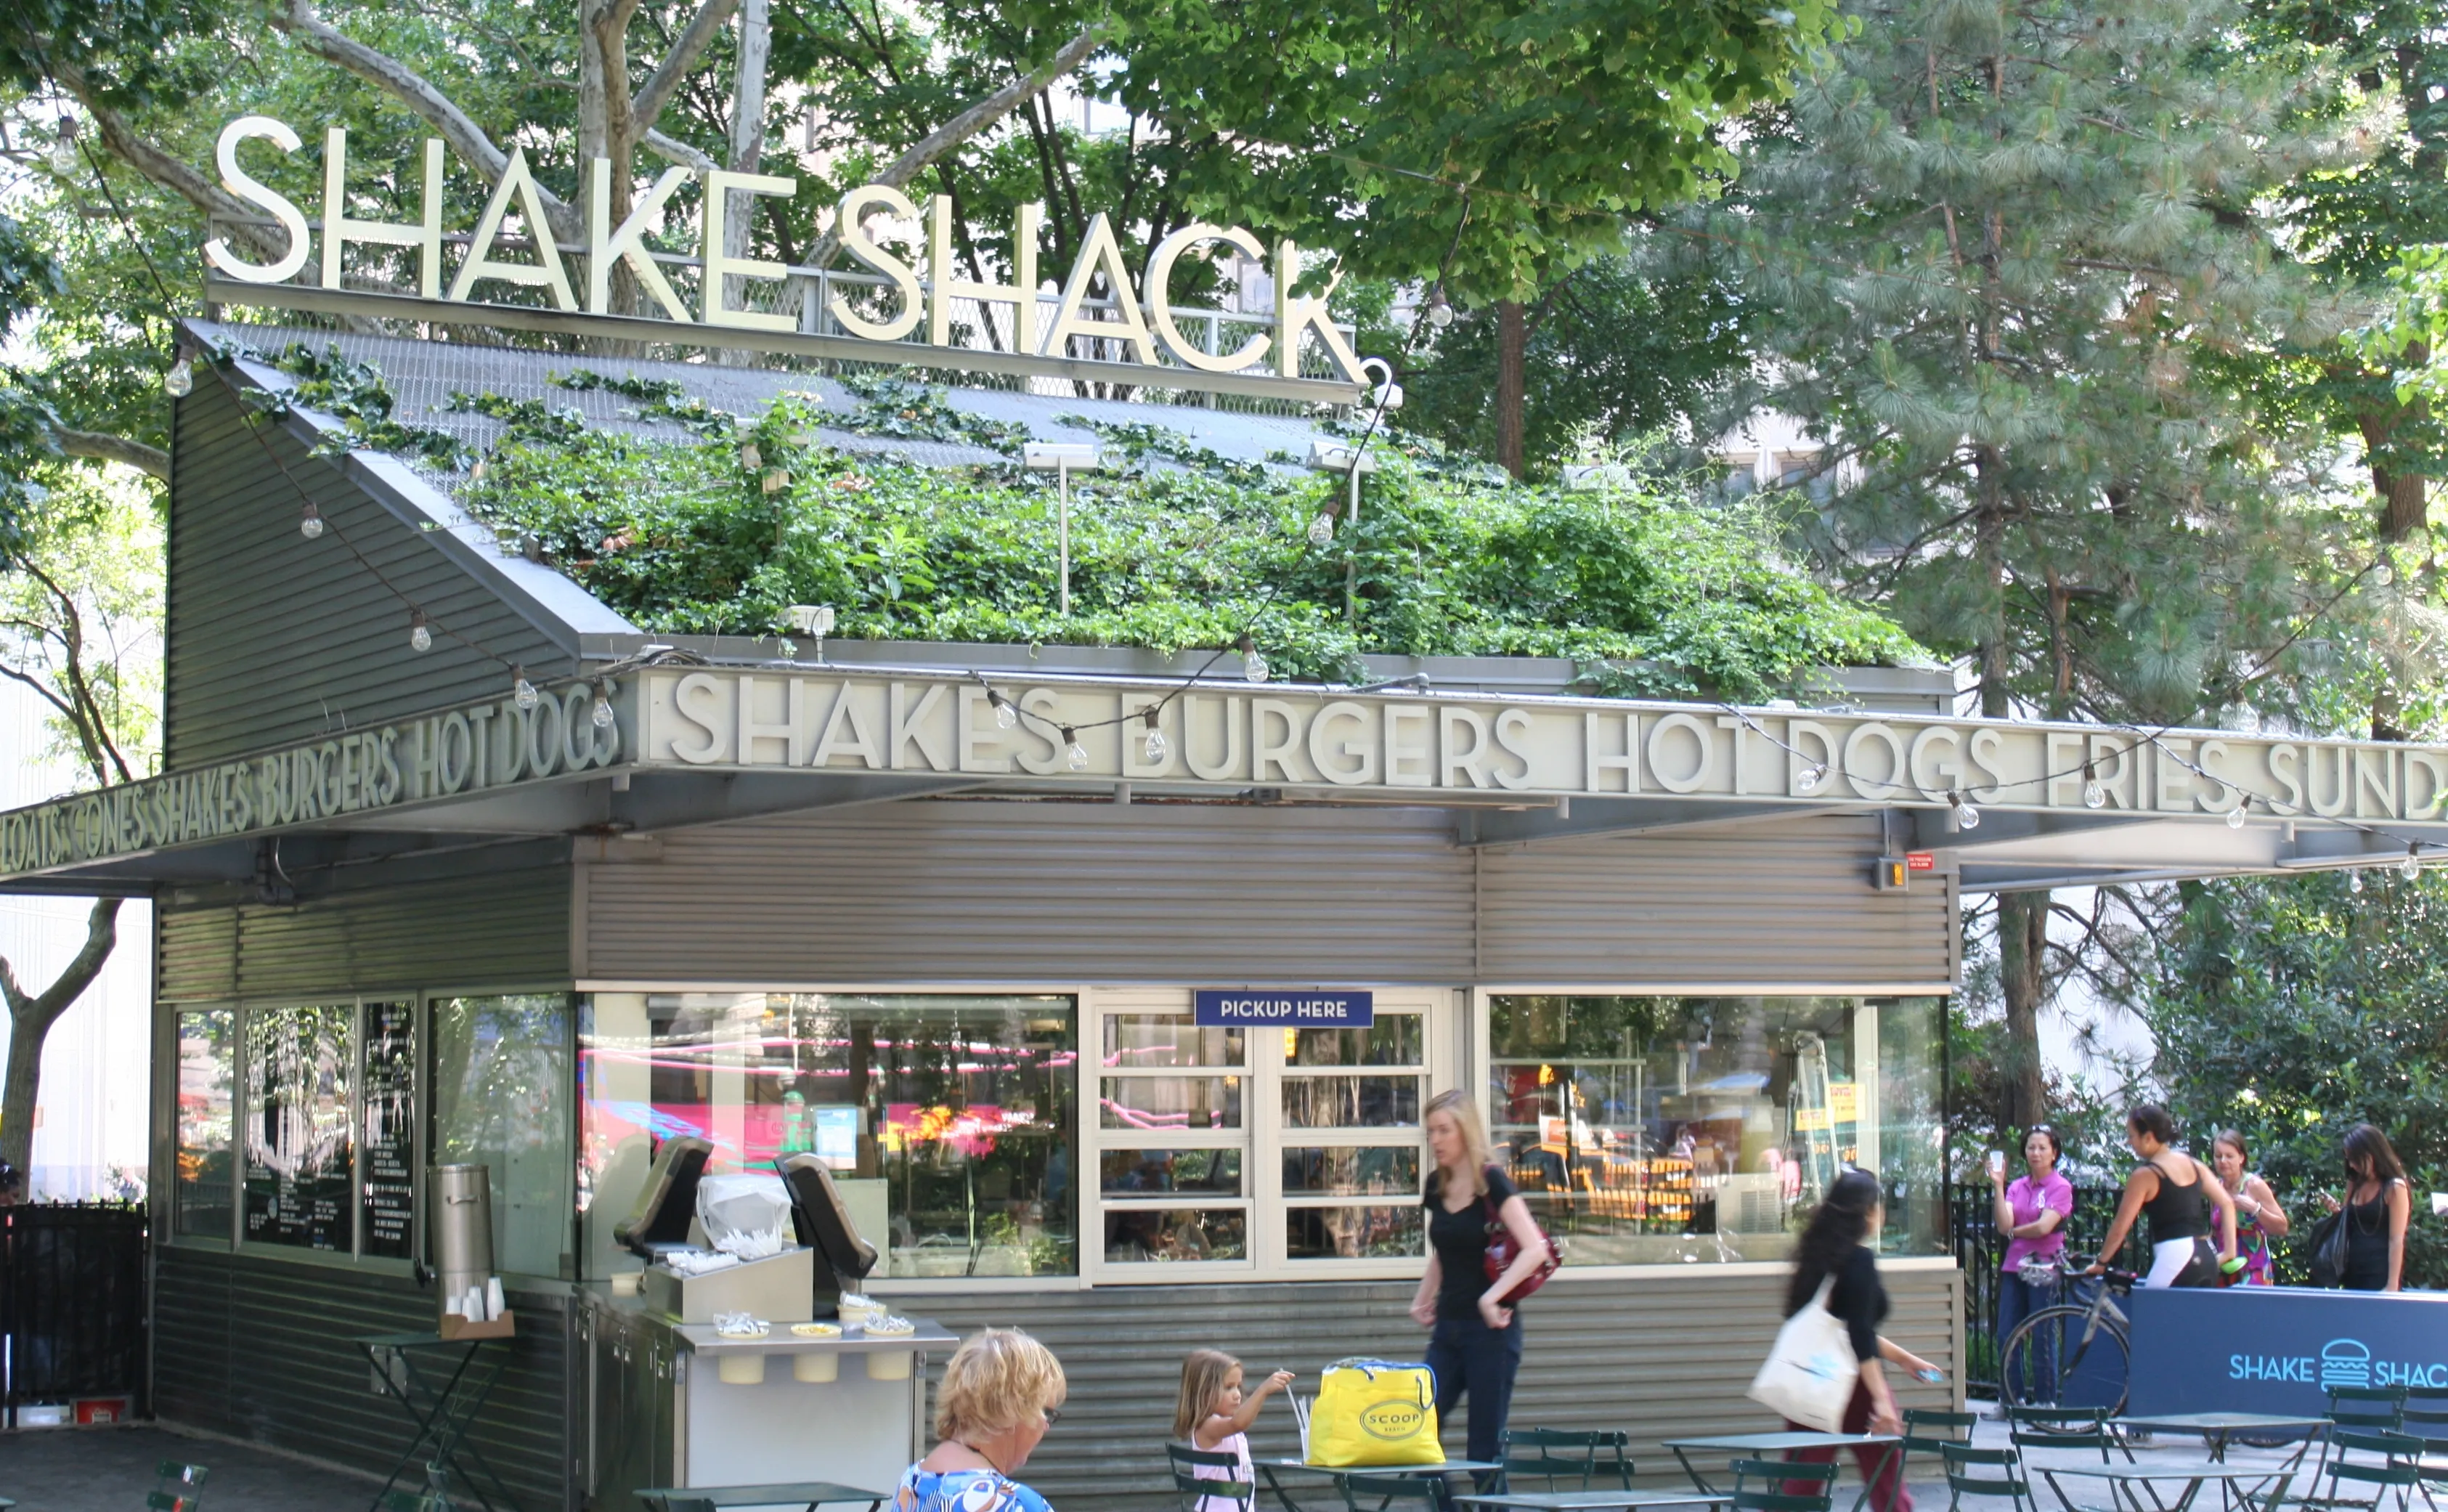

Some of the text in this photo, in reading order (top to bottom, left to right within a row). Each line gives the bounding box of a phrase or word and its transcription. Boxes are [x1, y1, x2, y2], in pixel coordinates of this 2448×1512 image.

[205, 115, 1373, 383] SHAKE SHACK
[70, 784, 145, 860] CONES
[153, 761, 250, 846] SHAKES
[262, 725, 399, 826] BURGERS
[414, 704, 495, 799] HOT
[501, 678, 619, 784] DOGS
[671, 673, 2448, 821] SHAKES BURGERS HOT DOGS FRIES SUND
[1221, 1000, 1348, 1018] PICKUP HERE
[2229, 1354, 2316, 1383] SHAKE
[1369, 1414, 1420, 1424] SCOOP
